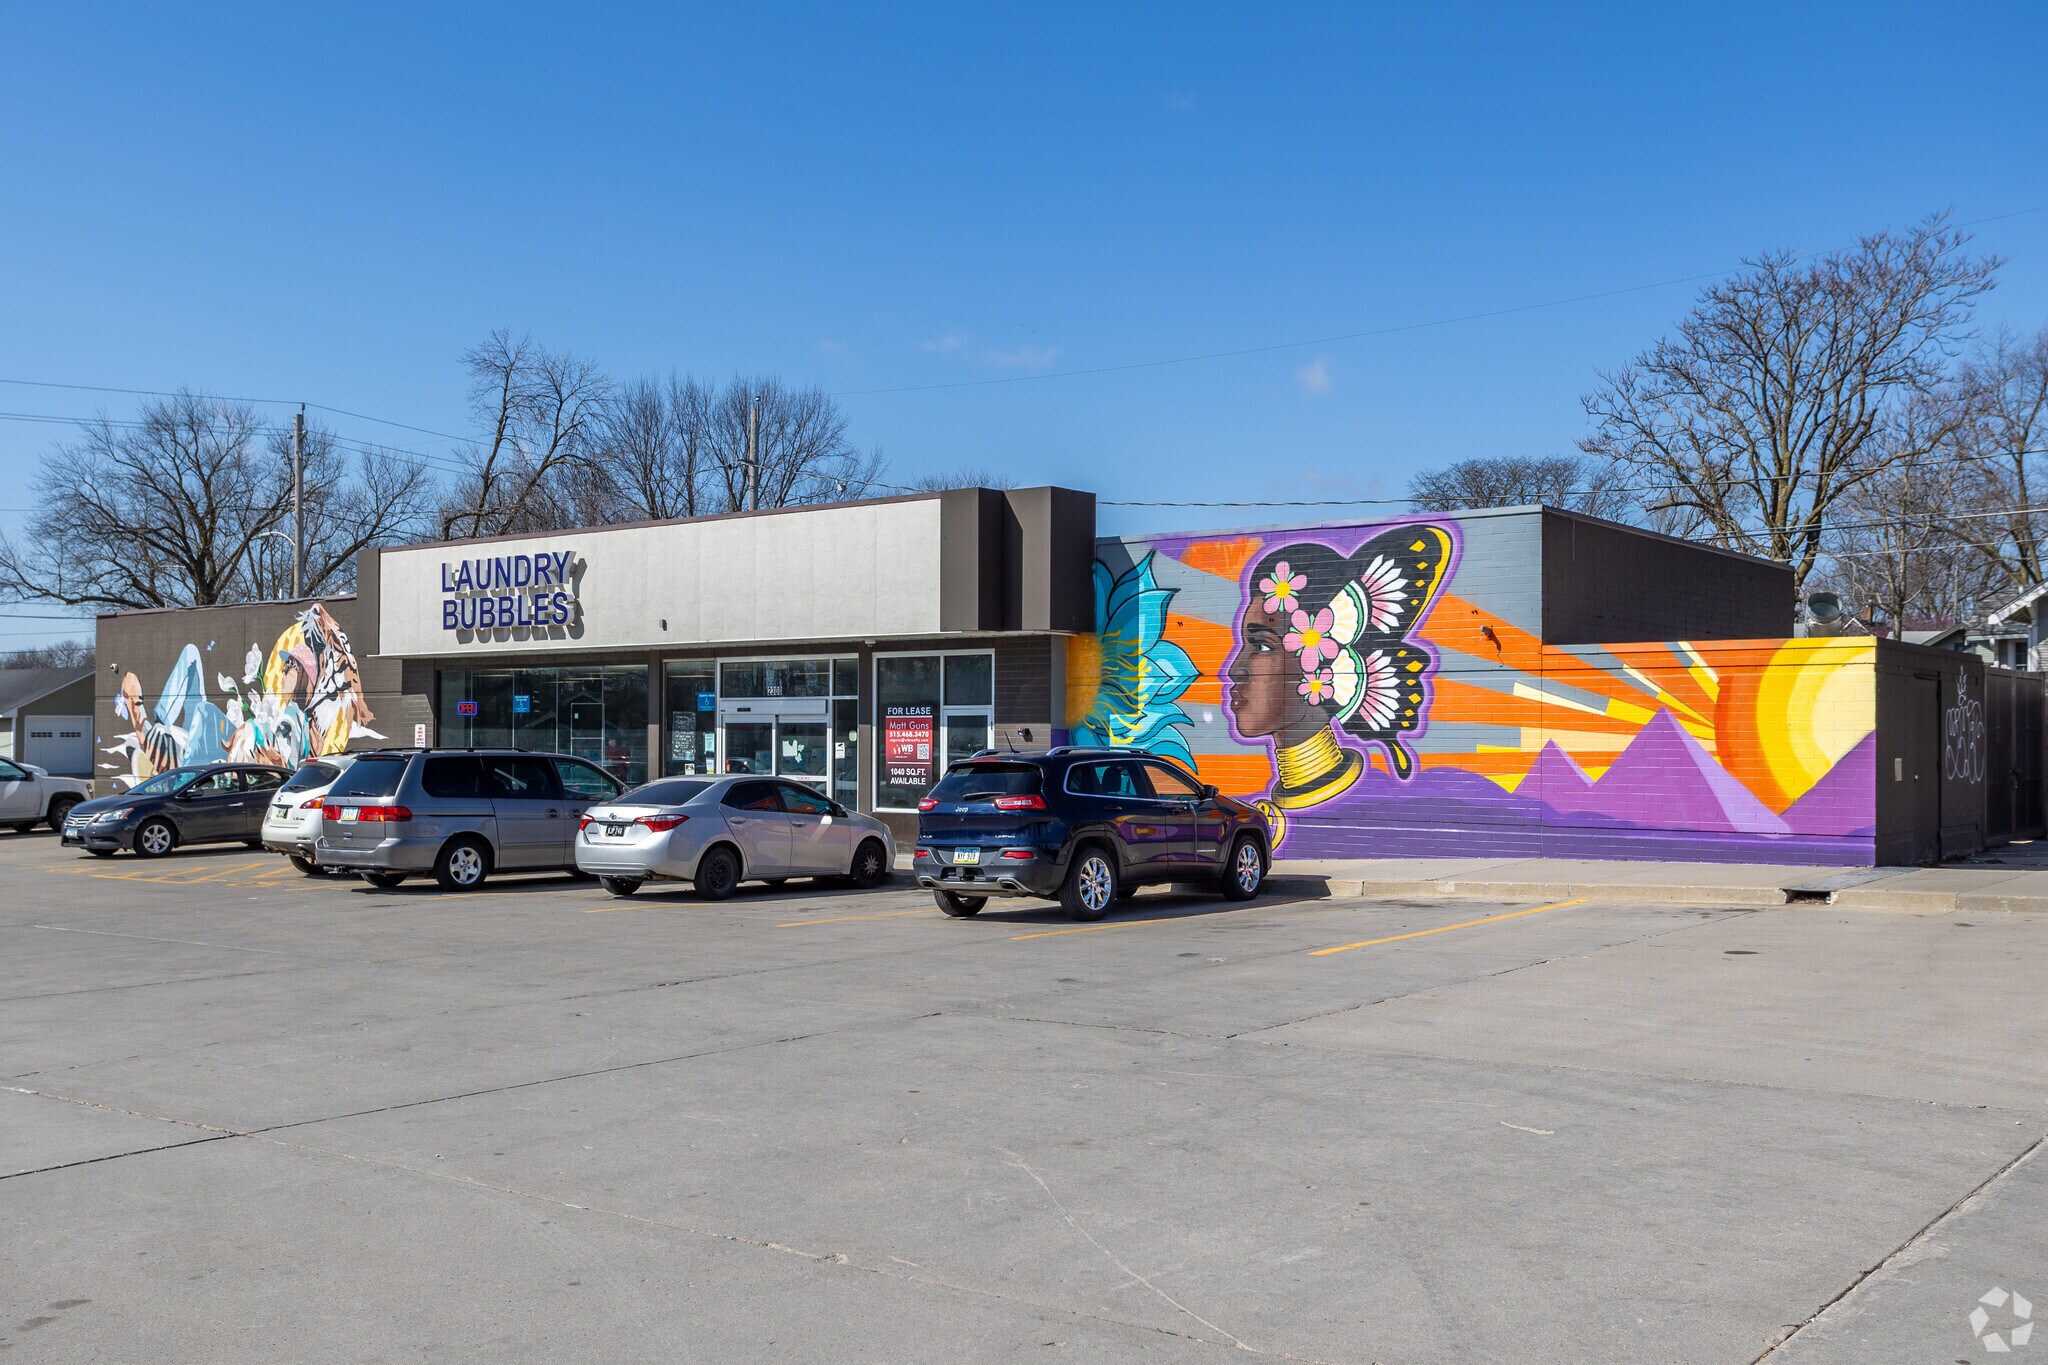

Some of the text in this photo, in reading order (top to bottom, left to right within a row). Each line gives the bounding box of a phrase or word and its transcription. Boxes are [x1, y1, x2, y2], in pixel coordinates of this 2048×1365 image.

[442, 550, 572, 593] LAUNDRY
[443, 591, 571, 630] BUBBLES
[459, 703, 476, 713] OPEN
[887, 706, 931, 715] FOR LEASE
[889, 720, 930, 730] Matt Guns
[900, 744, 914, 753] WB
[890, 767, 905, 776] 1040
[890, 777, 926, 785] AVAILABLE
